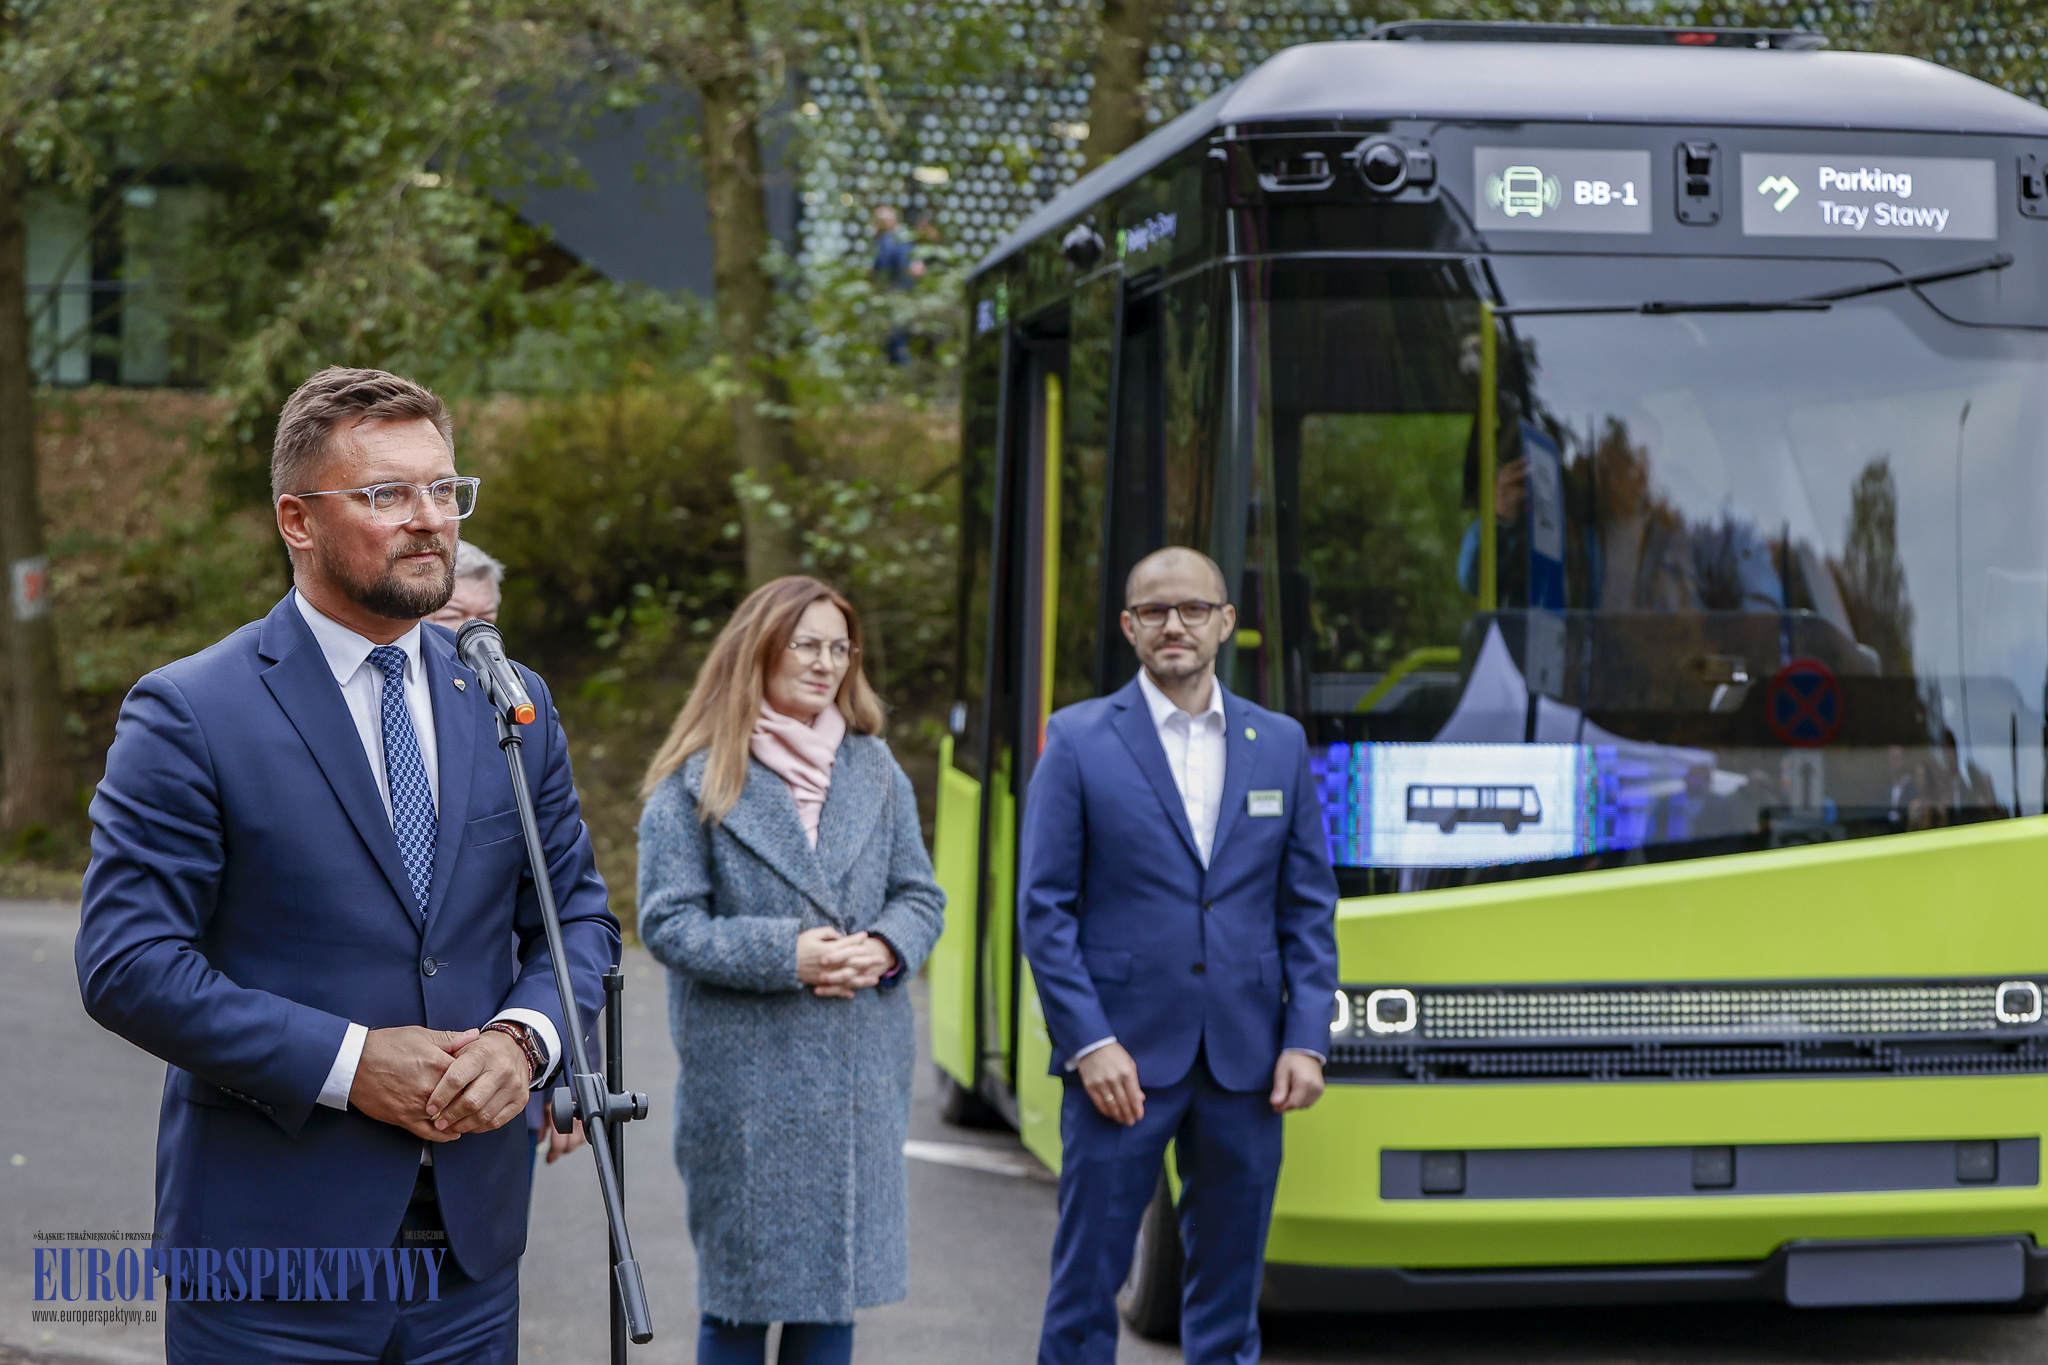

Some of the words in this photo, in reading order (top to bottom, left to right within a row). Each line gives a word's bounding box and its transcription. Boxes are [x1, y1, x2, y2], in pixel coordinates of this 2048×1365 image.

[1573, 180, 1639, 206] BB-1
[1818, 166, 1912, 199] Parking
[1817, 200, 1870, 232] Trzy
[1873, 201, 1950, 233] Stawy
